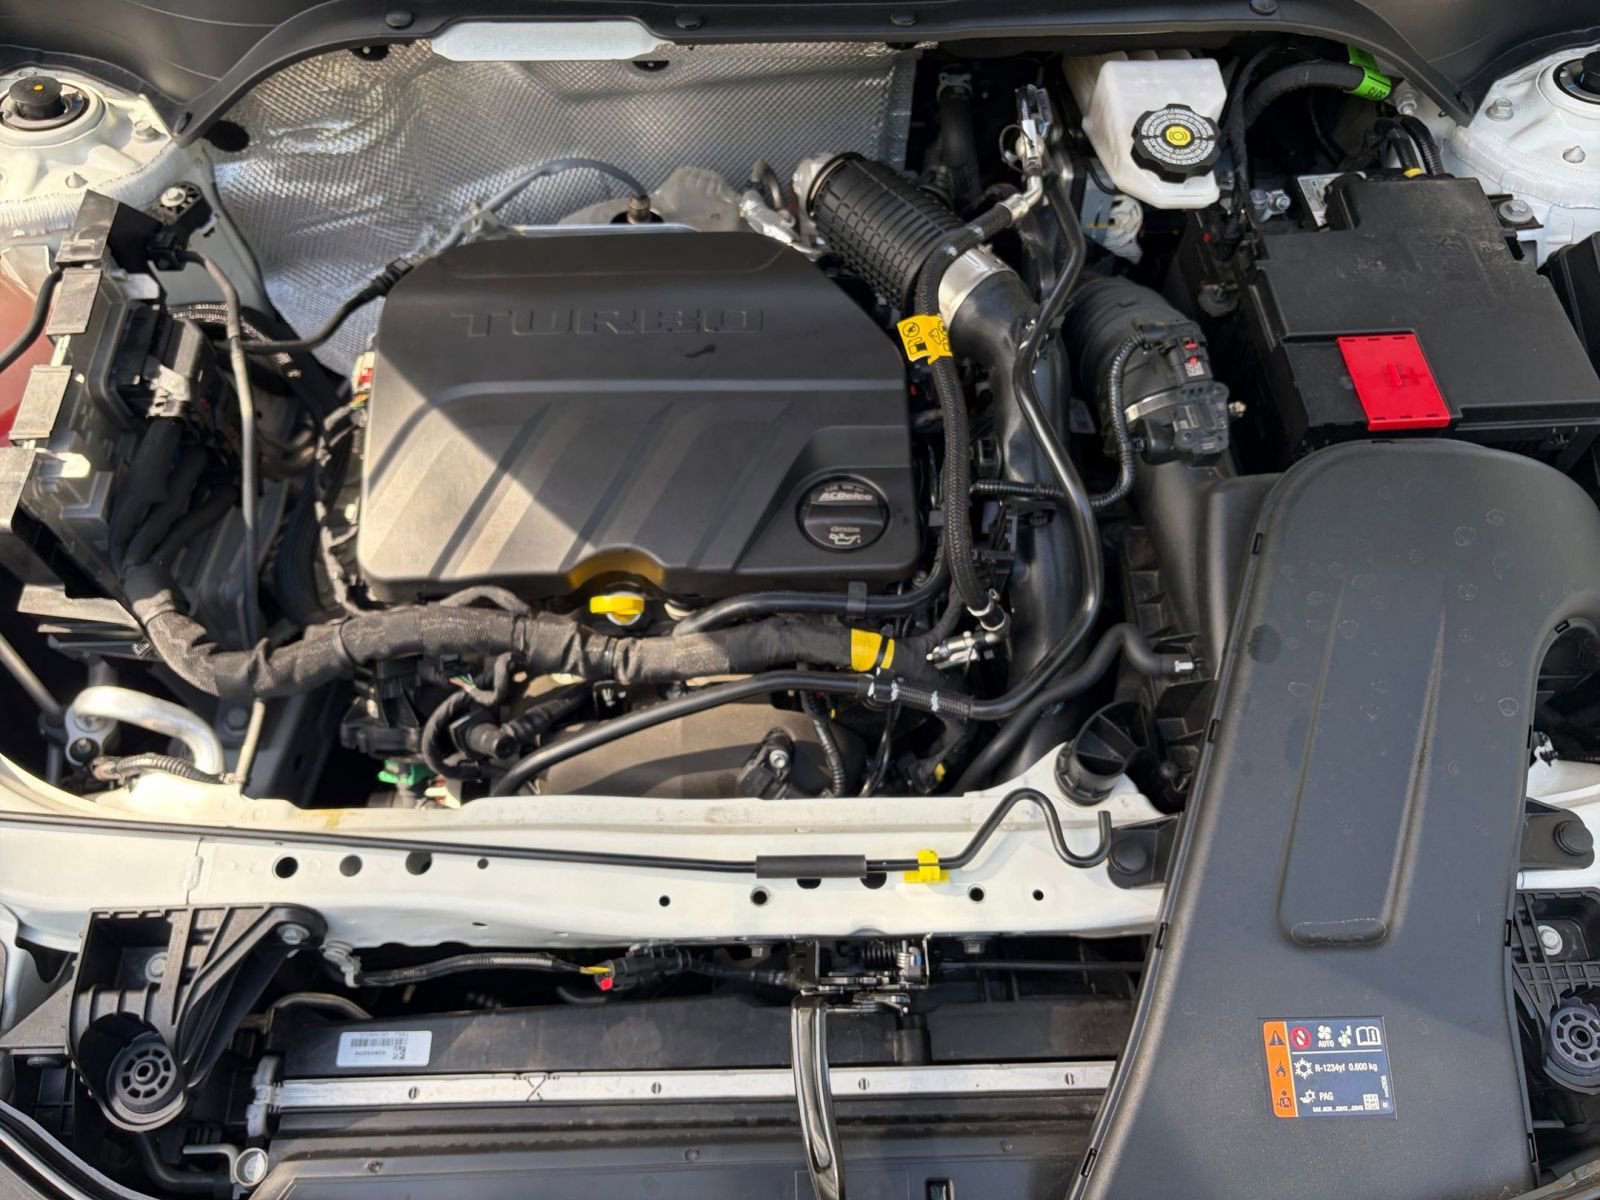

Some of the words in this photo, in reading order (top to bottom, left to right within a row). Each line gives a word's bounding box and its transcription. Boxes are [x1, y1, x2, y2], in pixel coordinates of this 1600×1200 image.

[451, 309, 764, 337] TURBO
[818, 492, 873, 501] ACDelco
[1318, 1040, 1335, 1048] AUTO
[1314, 1063, 1345, 1073] R-1234yf
[1348, 1062, 1368, 1072] 0.600
[1368, 1062, 1378, 1072] kg
[1319, 1091, 1334, 1101] PAG
